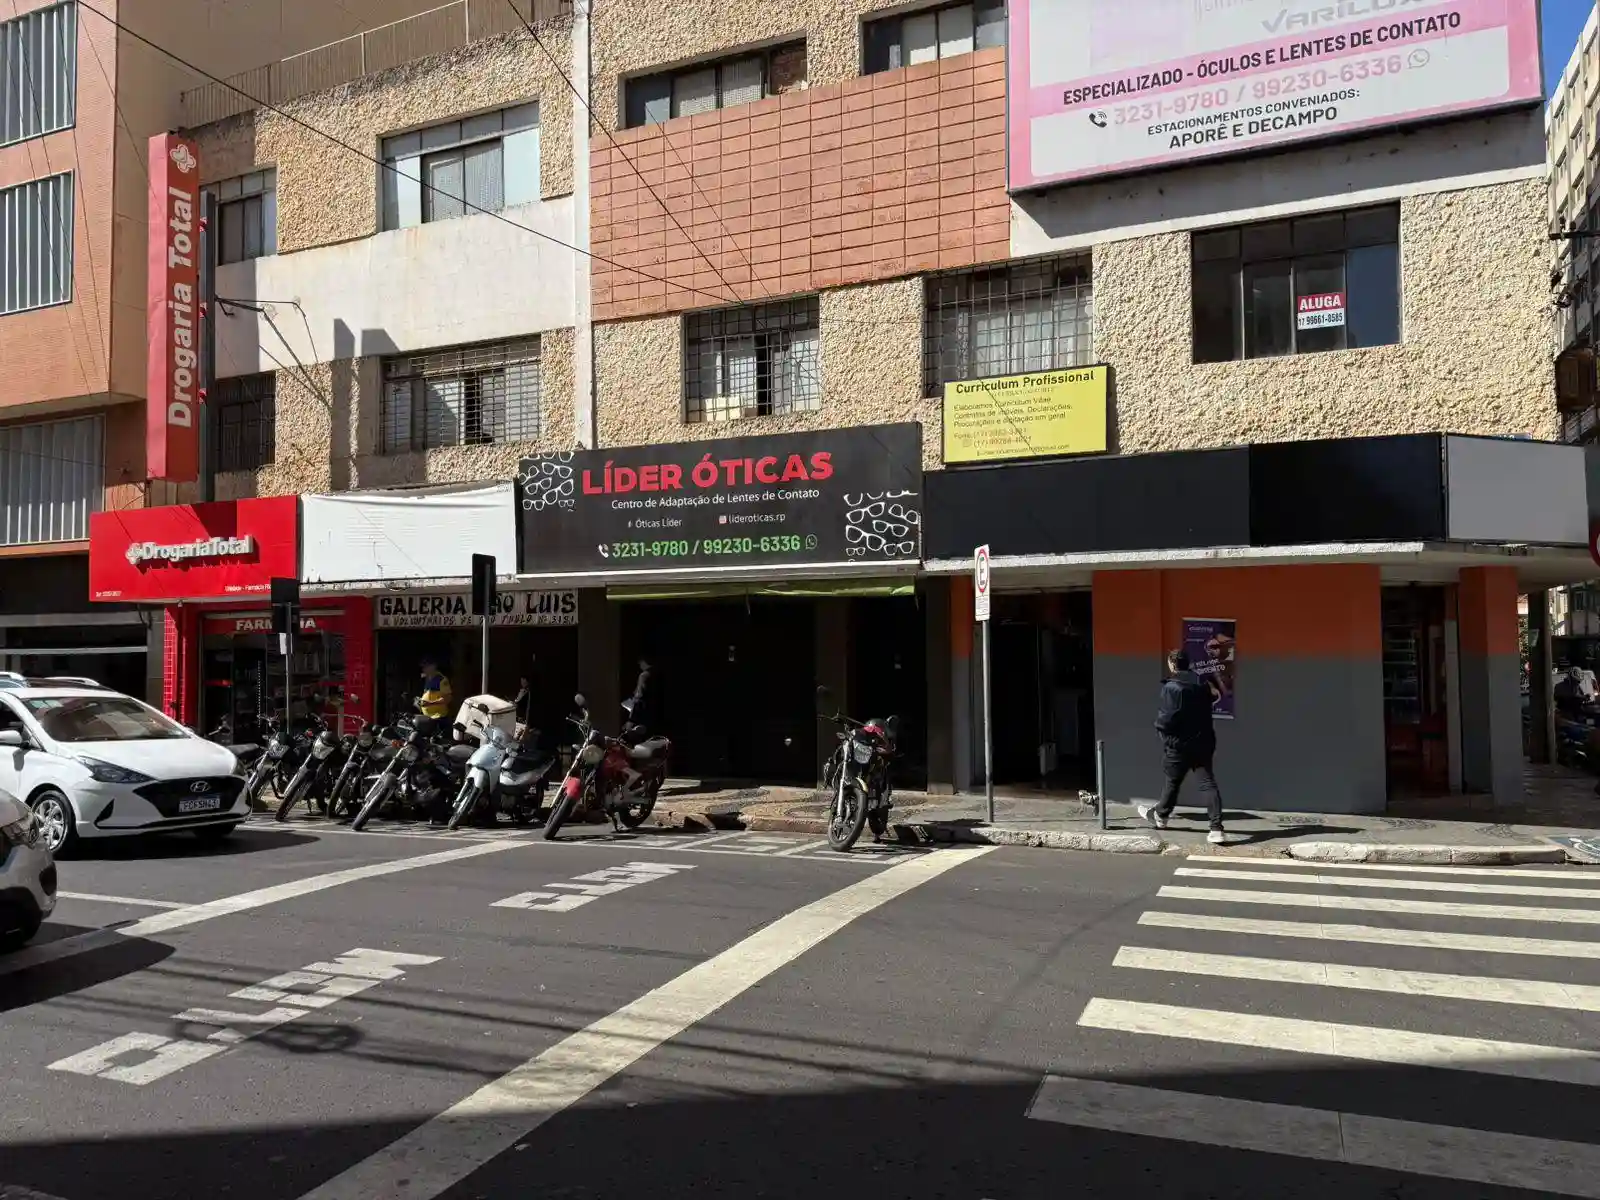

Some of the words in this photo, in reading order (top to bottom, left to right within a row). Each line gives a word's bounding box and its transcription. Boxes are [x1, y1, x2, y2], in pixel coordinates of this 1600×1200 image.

[1261, 0, 1421, 33] VARILU
[1063, 68, 1183, 105] ESPECIALIZADO
[1197, 50, 1261, 80] ÓCULOS
[1266, 47, 1276, 64] E
[1280, 34, 1347, 62] LENTES
[1350, 28, 1373, 47] DE
[1377, 11, 1461, 41] CONTATO
[1114, 89, 1229, 124] 3231-9780
[1236, 85, 1245, 105] /
[1253, 55, 1401, 98] 99230-6336
[1147, 106, 1262, 135] ESTACIONAMENTOS
[1265, 89, 1360, 116] CONVENIADOS:
[1169, 122, 1229, 149] APORÊ
[1233, 122, 1244, 139] E
[1248, 107, 1338, 137] DECAMPO
[168, 186, 193, 268] Total
[1299, 294, 1341, 310] ALUGA
[168, 283, 197, 427] Drogaria
[956, 380, 1019, 394] Curriculum
[1023, 370, 1095, 387] Profissional
[582, 461, 681, 494] LÍDER
[691, 452, 834, 487] ÓTICAS
[611, 498, 642, 509] Centro
[644, 497, 657, 508] de
[659, 493, 710, 508] Adaptação
[712, 493, 725, 504] de
[728, 491, 759, 503] Lentes
[762, 490, 775, 501] de
[778, 487, 819, 500] Contato
[635, 516, 661, 528] Óticas
[662, 516, 682, 527] Líder
[729, 512, 786, 526] lideroticas.rp
[141, 534, 253, 563] DrogariaTotal
[612, 540, 688, 558] 3231-9780
[692, 539, 699, 555] /
[704, 536, 800, 554] 99230-6336
[380, 596, 467, 615] GALERIA
[527, 592, 576, 614] LUIS
[45, 948, 446, 1085] MOTO
